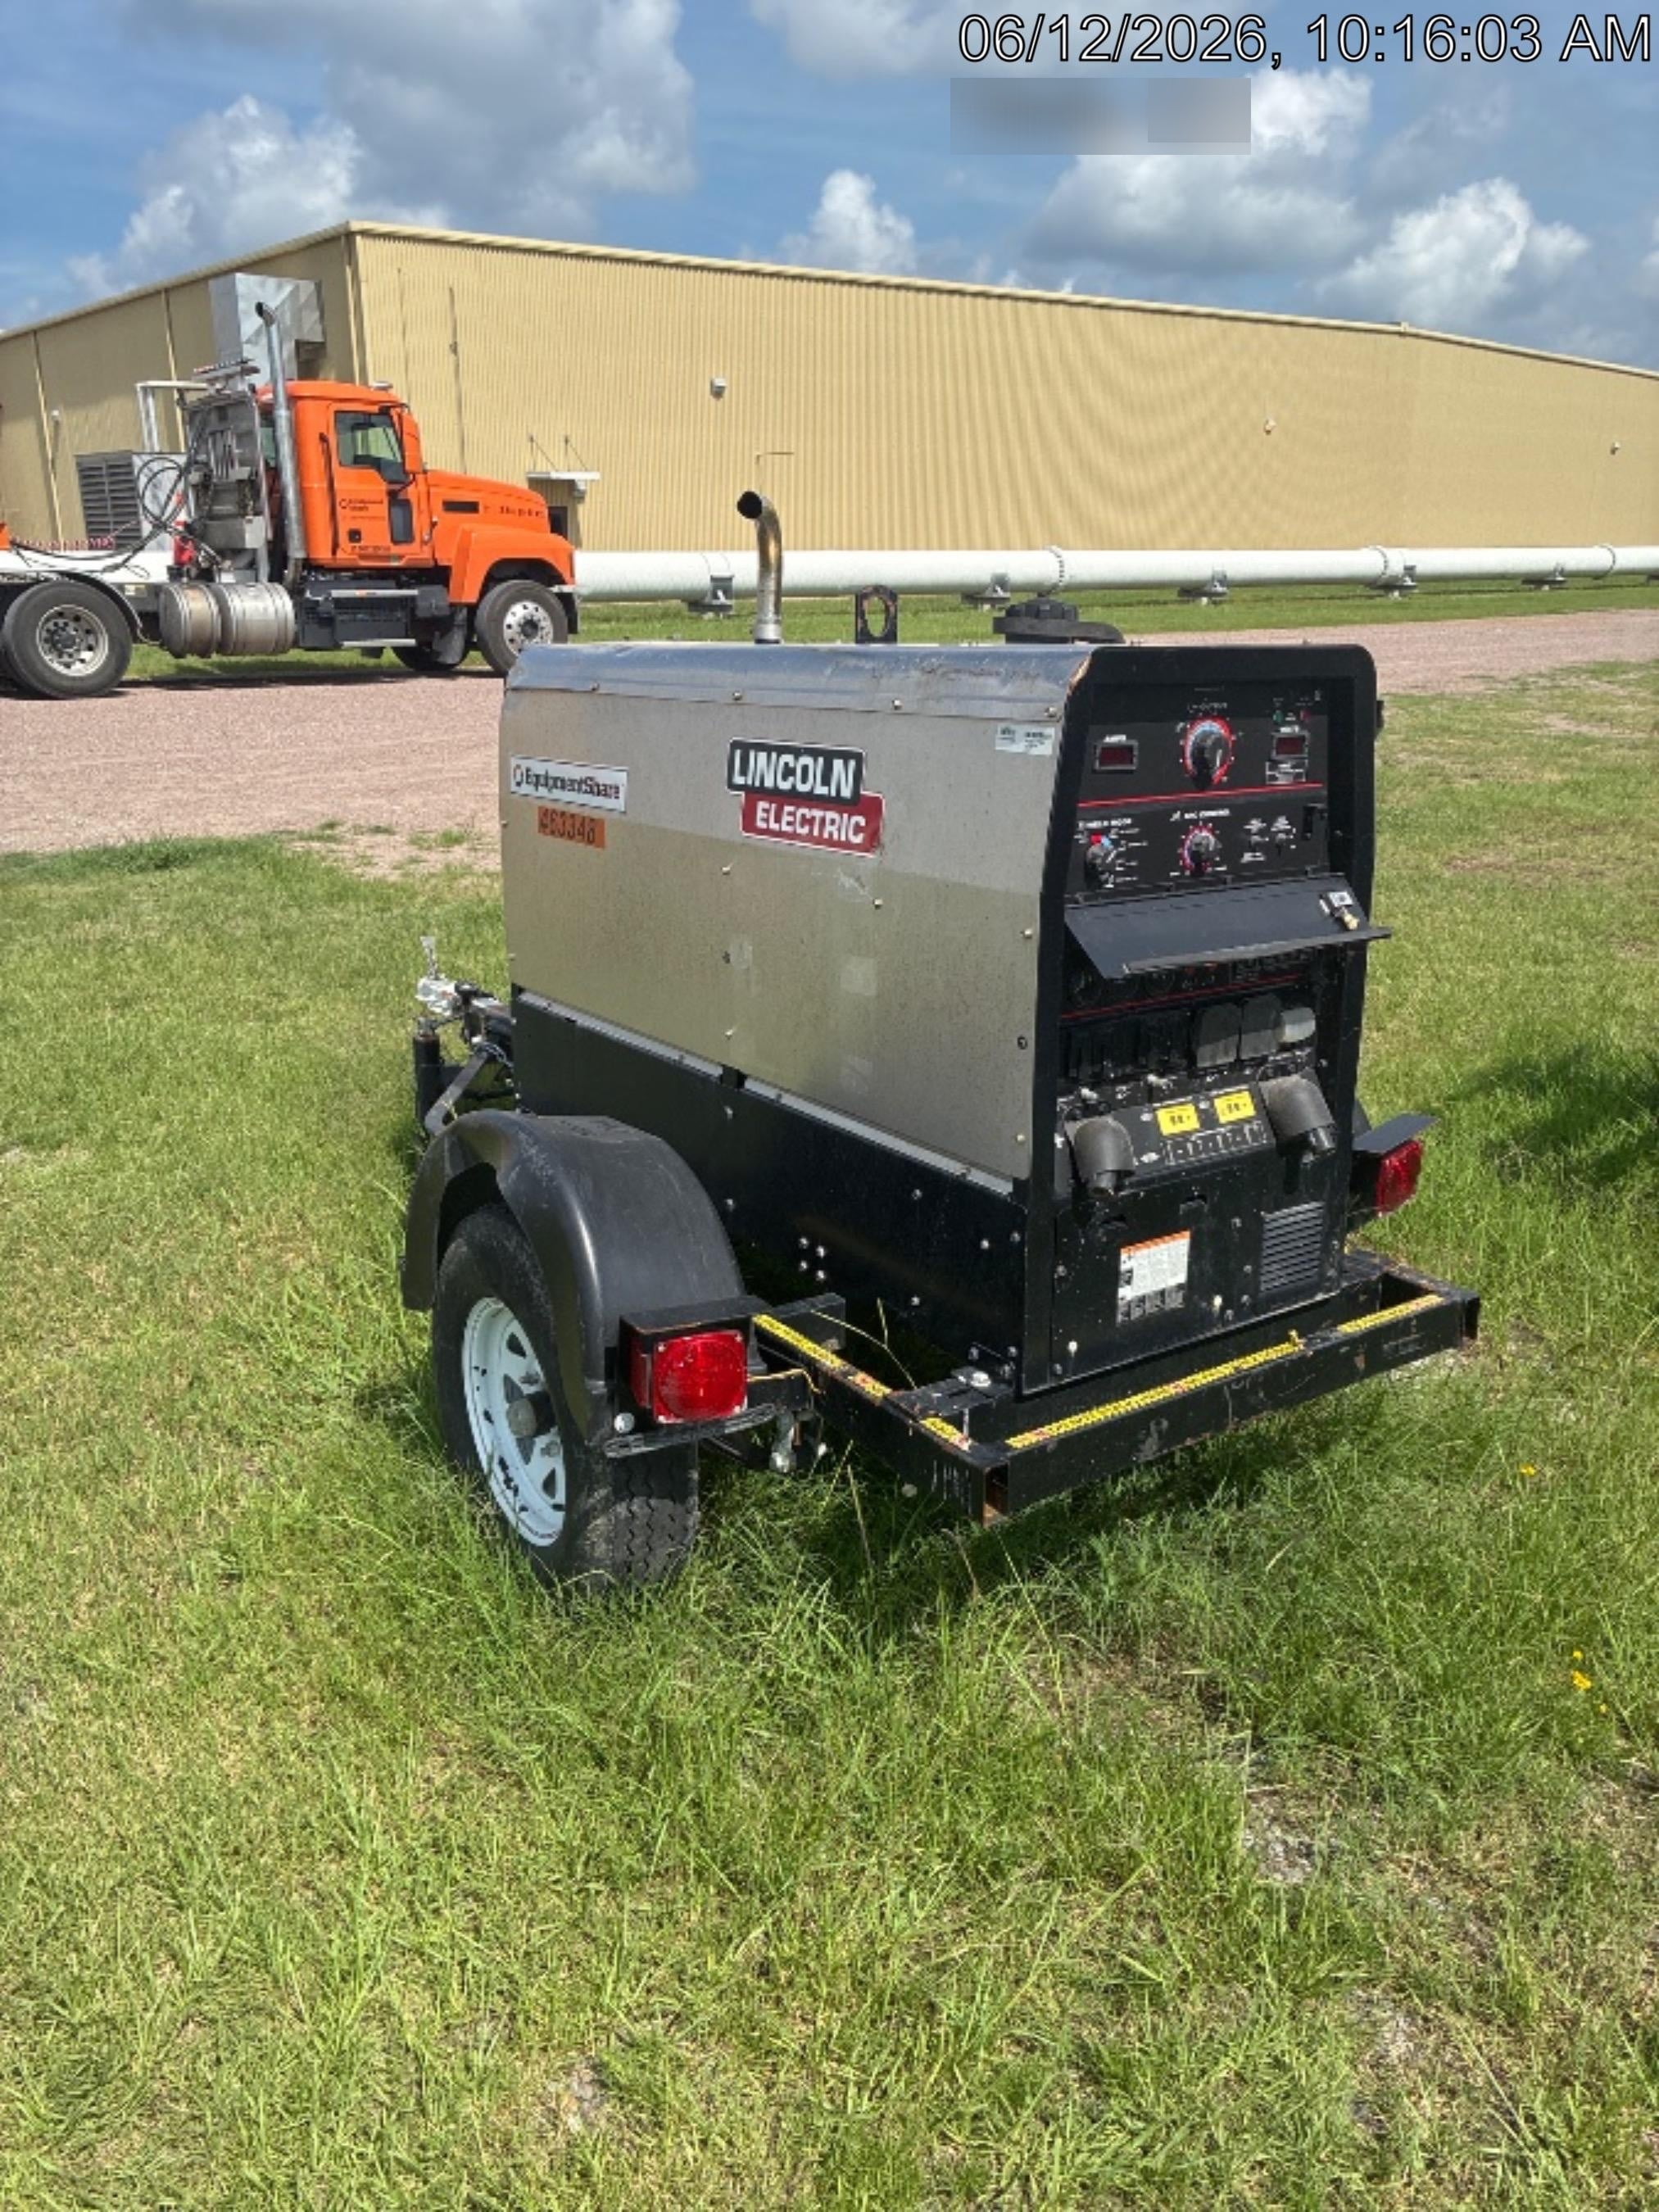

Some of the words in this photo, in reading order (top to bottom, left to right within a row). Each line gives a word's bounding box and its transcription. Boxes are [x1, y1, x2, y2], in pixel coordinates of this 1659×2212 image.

[525, 767, 621, 800] EquipmentShare
[732, 749, 857, 800] LINCOLN
[755, 800, 866, 844] ELECTRIC
